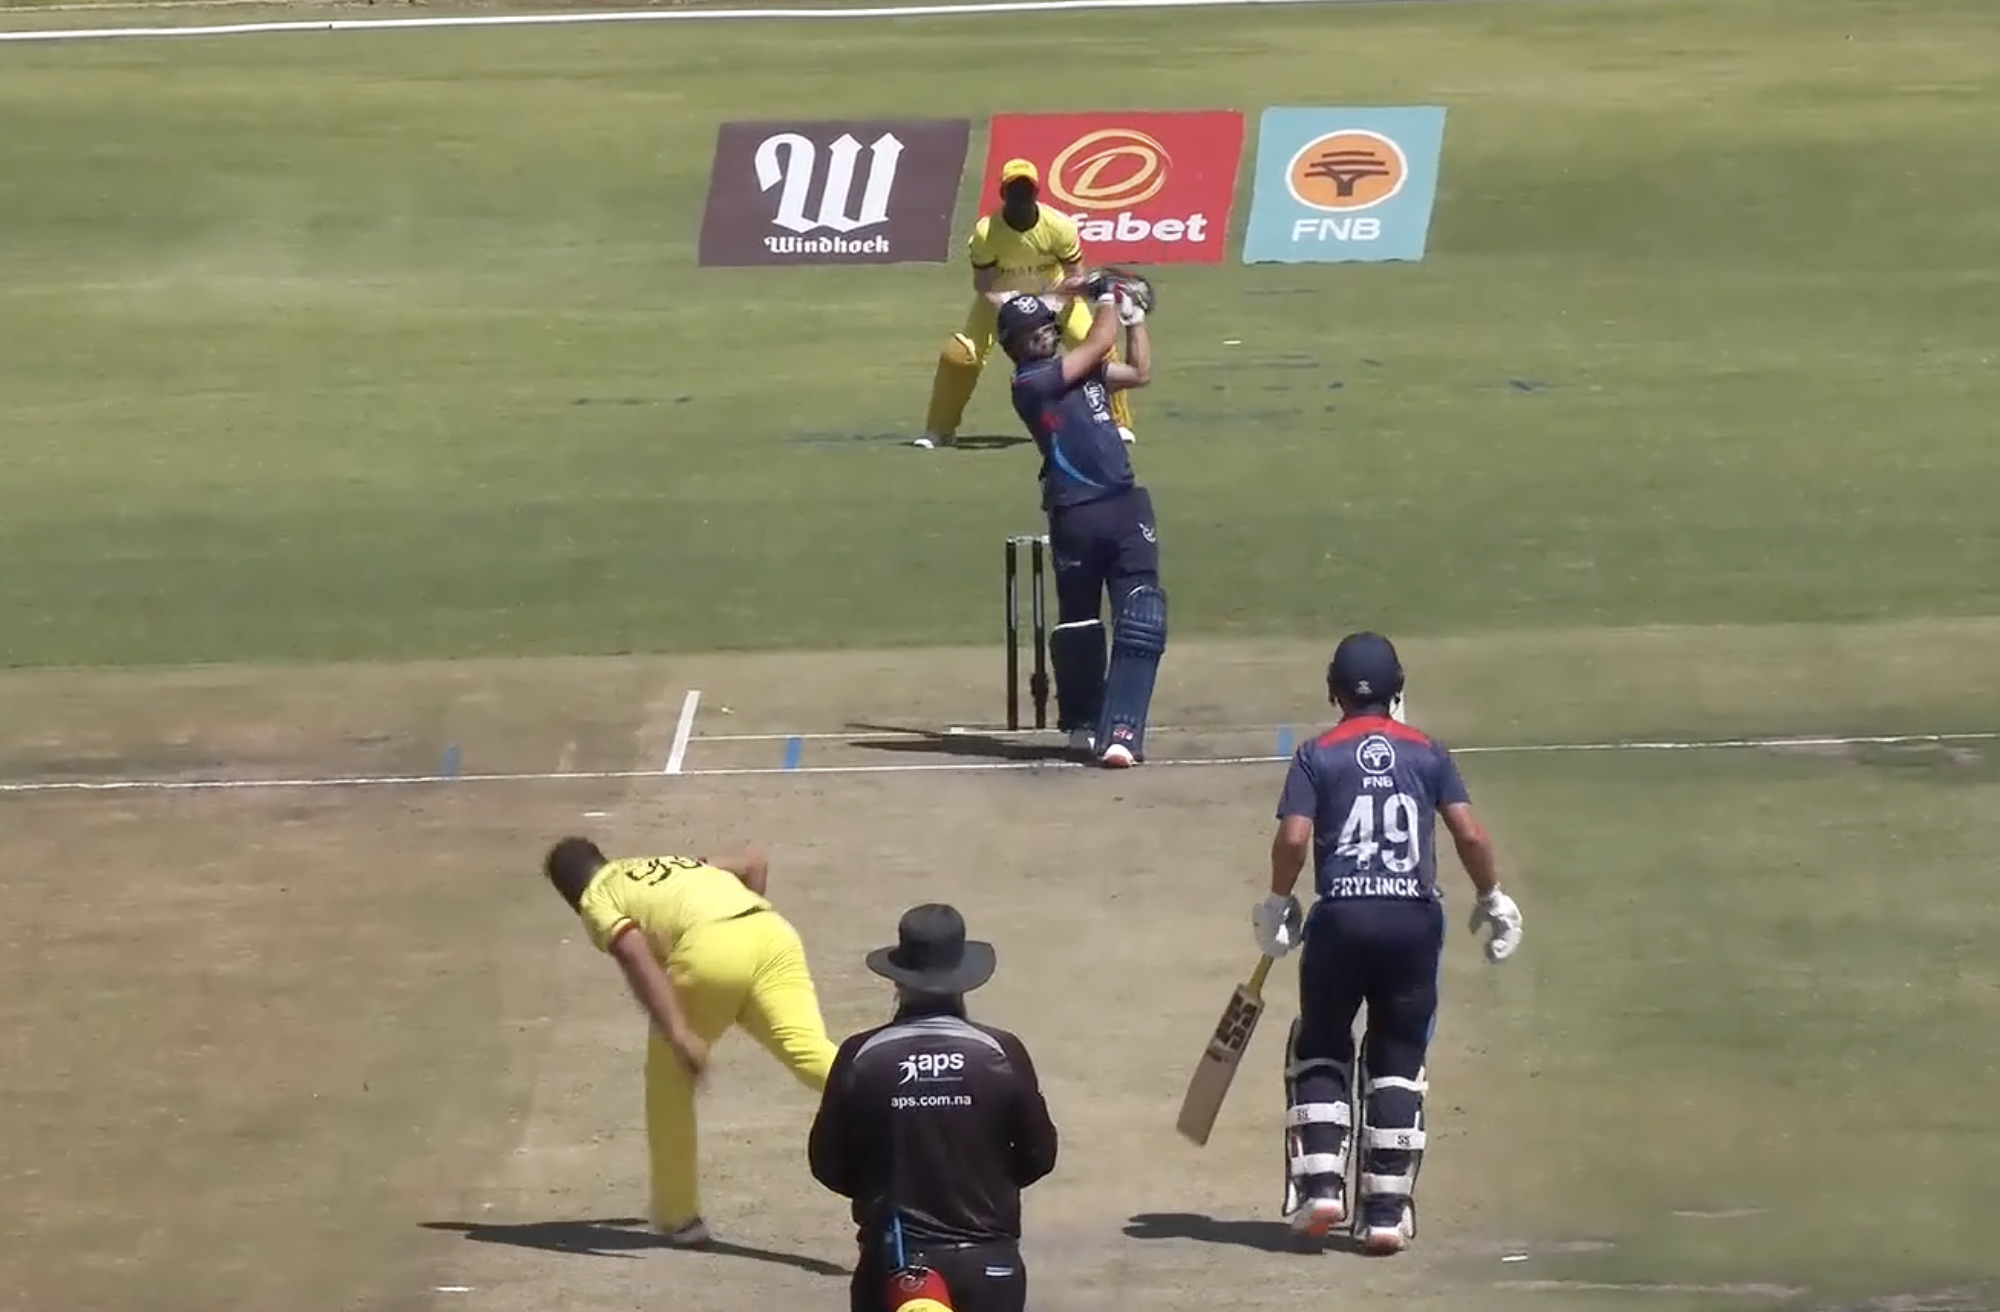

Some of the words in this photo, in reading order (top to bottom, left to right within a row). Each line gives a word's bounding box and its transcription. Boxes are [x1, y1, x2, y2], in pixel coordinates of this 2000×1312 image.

[1071, 211, 1208, 242] fabet
[1291, 218, 1381, 241] FNB
[764, 235, 890, 254] Windhoek
[1363, 776, 1394, 788] FNB
[1335, 792, 1420, 872] 49
[1331, 877, 1420, 897] FRYLINCK
[918, 1053, 965, 1077] aps
[891, 1095, 973, 1109] aps.com.na
